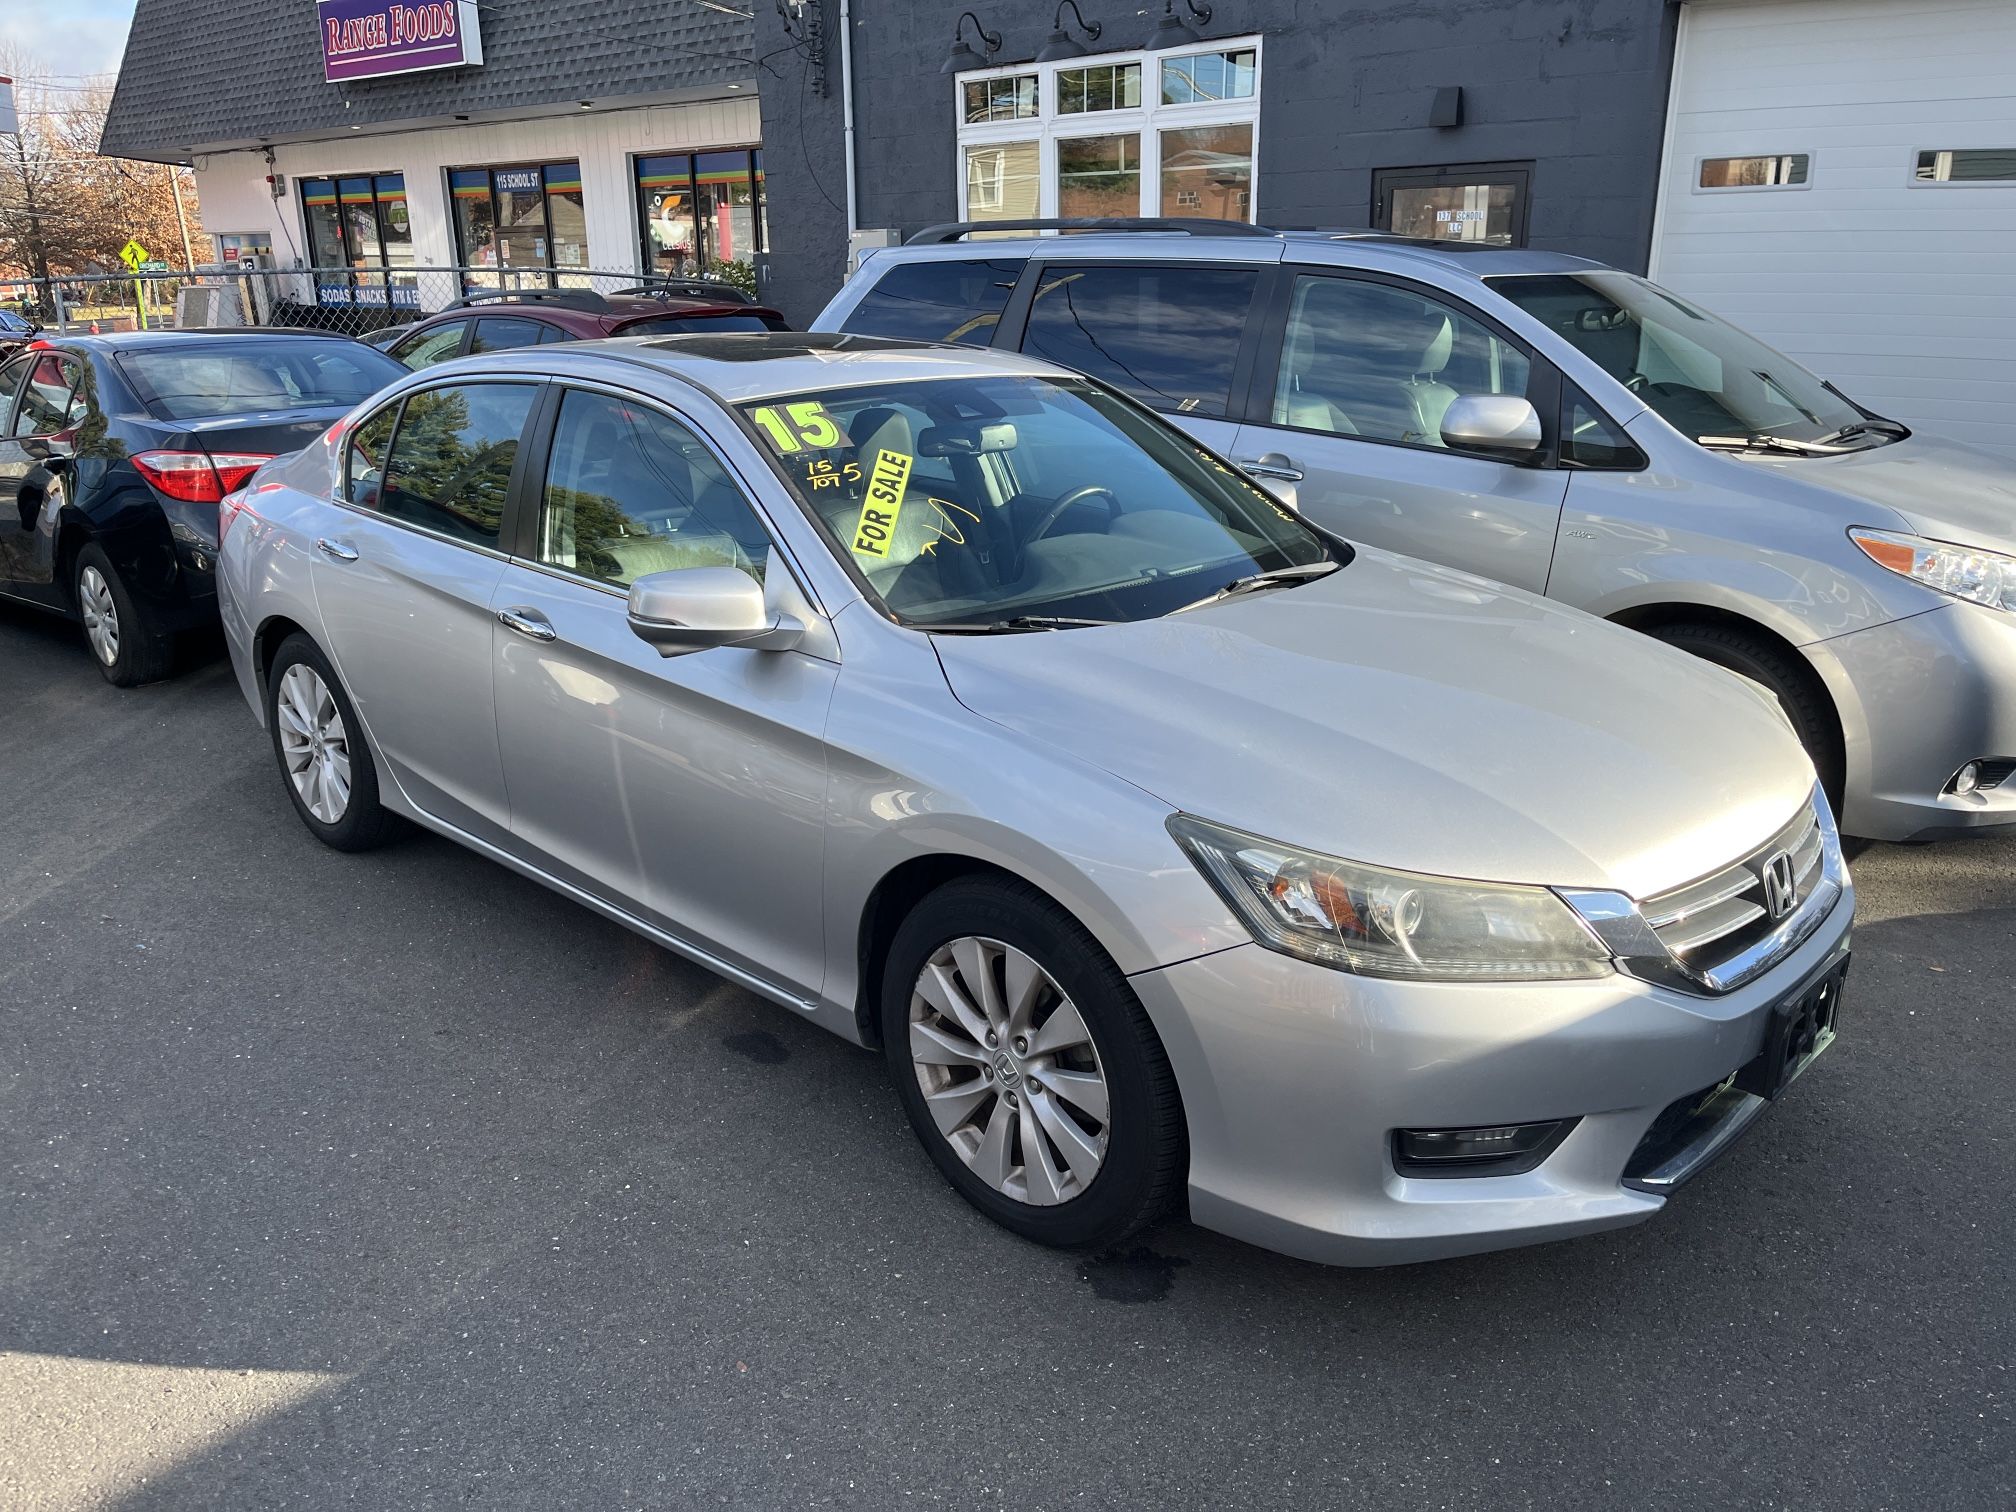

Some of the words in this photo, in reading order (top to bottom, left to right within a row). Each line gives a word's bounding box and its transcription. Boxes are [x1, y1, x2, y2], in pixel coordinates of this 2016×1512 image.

[326, 13, 388, 55] RANGE
[390, 1, 455, 45] FOODS
[496, 174, 507, 188] 115
[508, 173, 530, 188] SCHOOL
[531, 172, 539, 187] ST
[1438, 211, 1451, 220] 137
[1457, 211, 1483, 220] SCHOOL
[662, 239, 692, 250] CELSIUS
[321, 289, 351, 303] SODAS
[355, 289, 387, 304] SNACKS
[392, 289, 404, 304] ATM
[406, 290, 411, 304] &
[755, 402, 840, 452] 15
[871, 452, 908, 505] SALE
[856, 509, 893, 556] FOR
